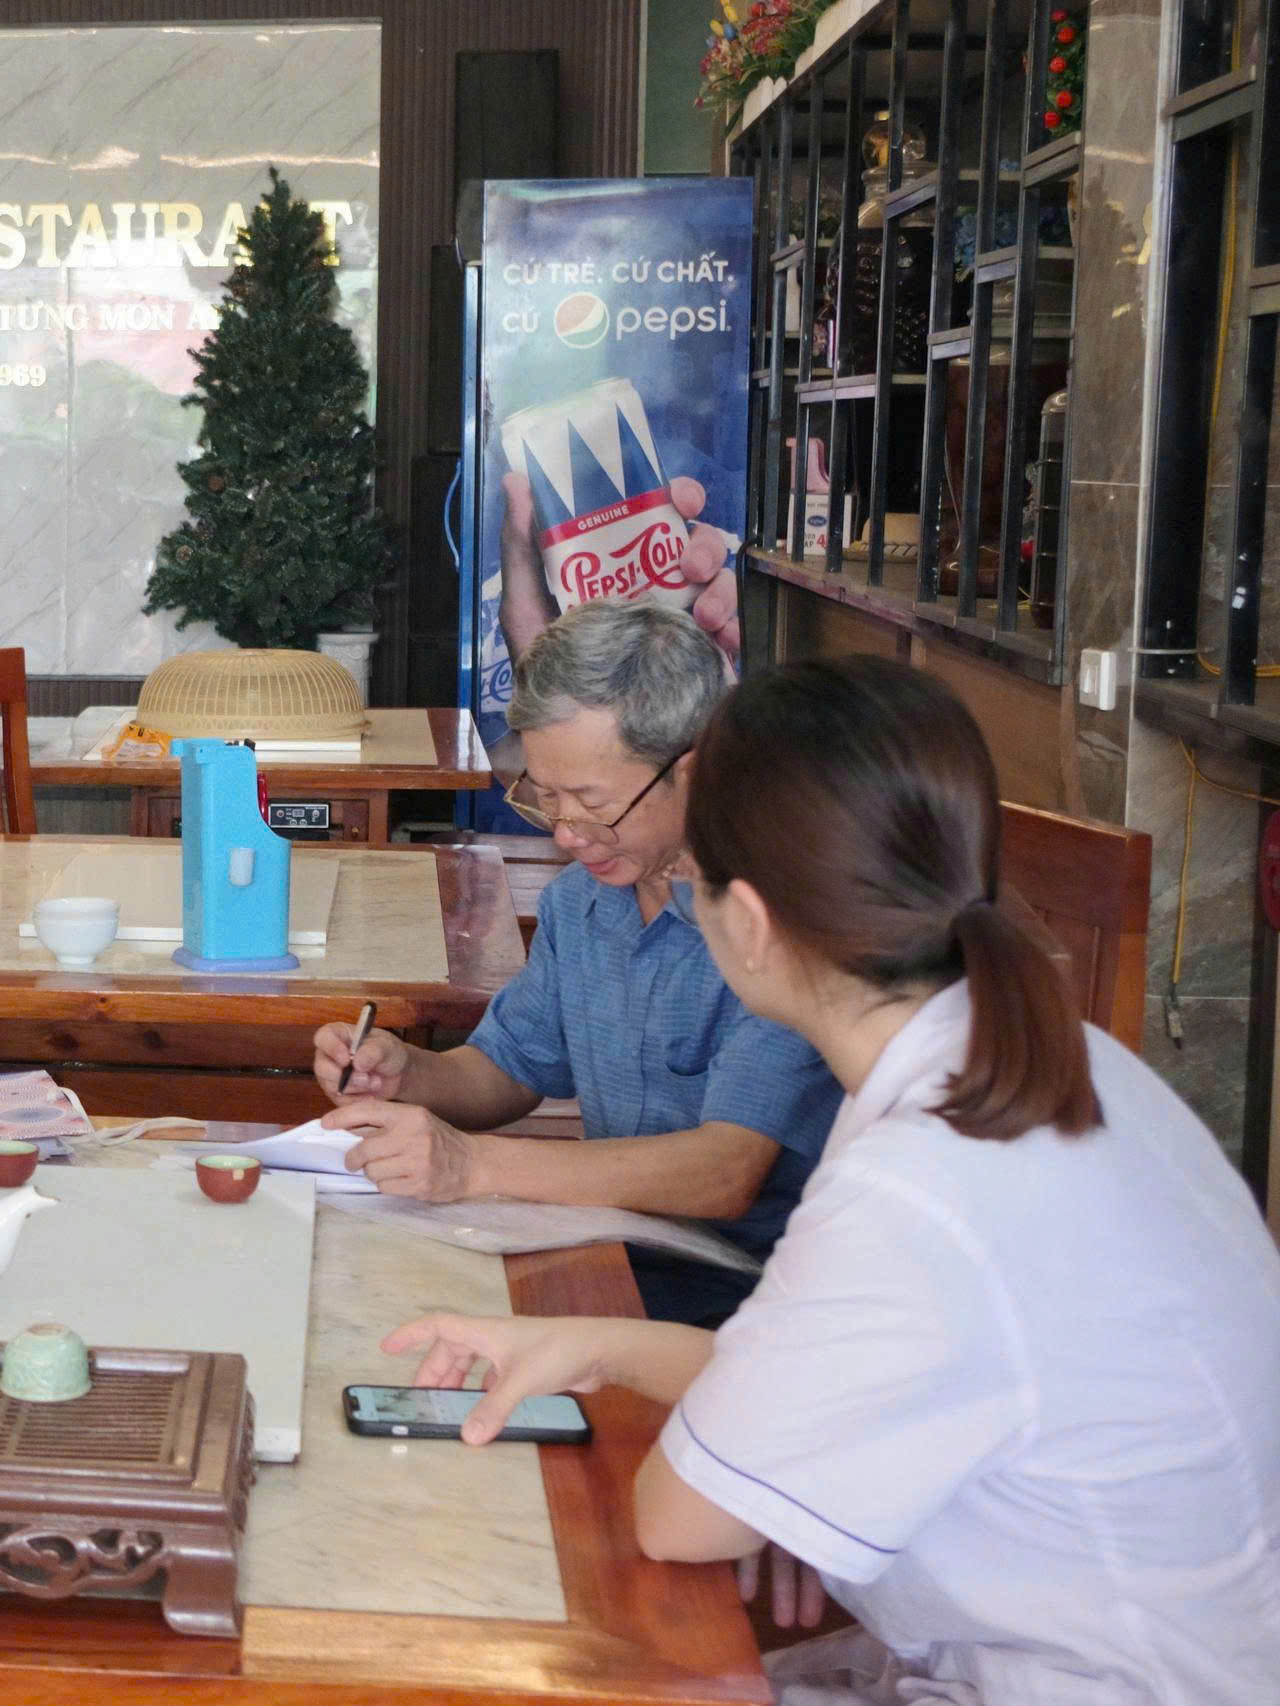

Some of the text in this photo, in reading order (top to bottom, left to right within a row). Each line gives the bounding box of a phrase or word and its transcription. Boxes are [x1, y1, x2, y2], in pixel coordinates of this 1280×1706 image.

[503, 256, 543, 285] CỨ
[611, 256, 652, 284] CỨ
[656, 251, 735, 284] CHẤT.
[615, 298, 728, 341] pepsi
[577, 504, 630, 531] GENUINE
